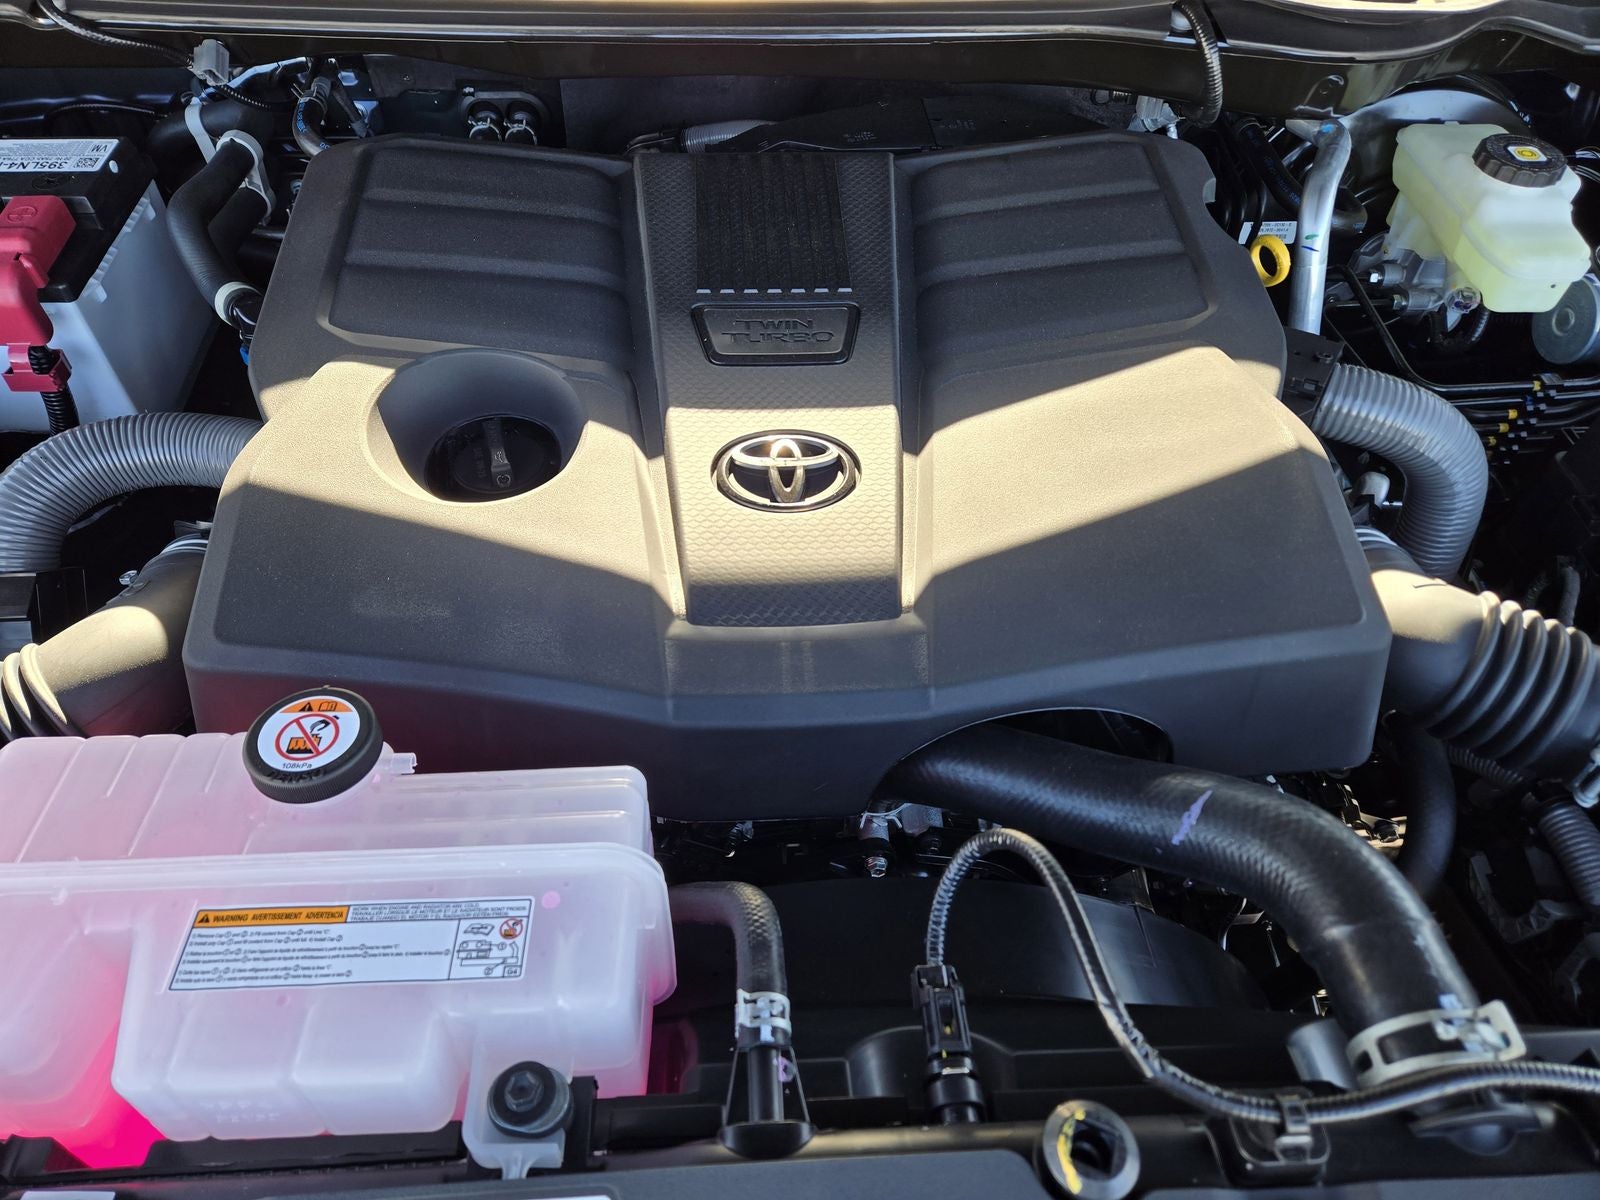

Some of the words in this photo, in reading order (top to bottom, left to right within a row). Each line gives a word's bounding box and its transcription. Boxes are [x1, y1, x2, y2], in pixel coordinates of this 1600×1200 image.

[91, 144, 108, 152] VM
[0, 161, 68, 169] 395LN4-
[735, 319, 814, 330] TWIN
[720, 331, 834, 343] TURBO
[213, 914, 249, 922] WARNING
[252, 912, 302, 920] AVERTISSEMENT
[305, 911, 344, 919] ADVERTENCIA
